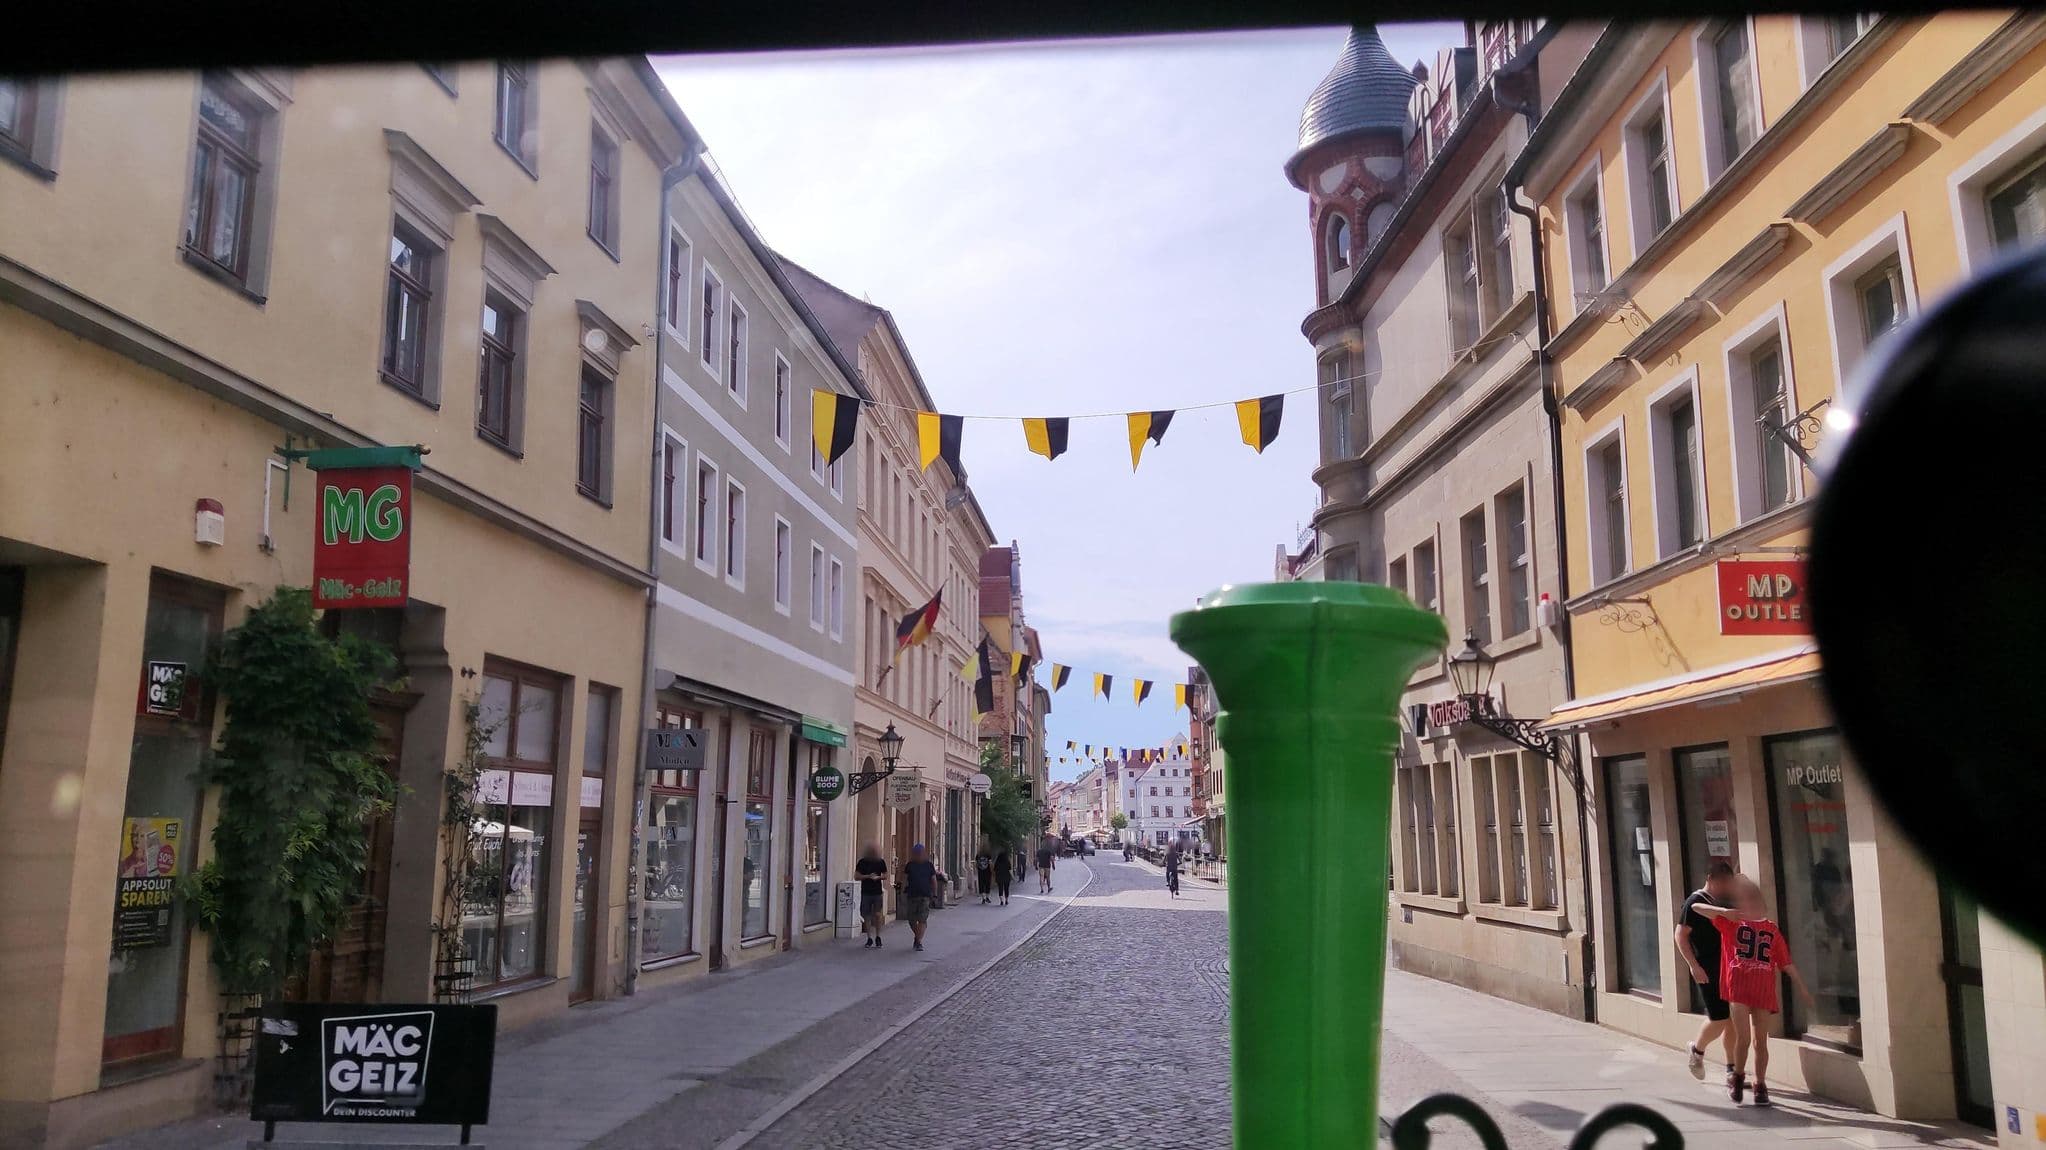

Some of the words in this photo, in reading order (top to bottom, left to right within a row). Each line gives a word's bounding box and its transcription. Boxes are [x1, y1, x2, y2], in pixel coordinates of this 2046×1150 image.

[324, 485, 402, 545] MG
[319, 577, 401, 600] Mäc-Geiz
[1746, 573, 1793, 599] MP
[1726, 604, 1802, 621] OUTLE
[1427, 696, 1488, 728] Volksbak
[1786, 766, 1804, 786] MP
[1806, 764, 1842, 784] Outlet
[122, 879, 172, 892] APPSOLUT
[1735, 925, 1775, 964] 92
[334, 1023, 422, 1057] MÄC
[329, 1060, 418, 1094] GEIZ
[334, 1107, 356, 1116] DEIN
[358, 1108, 416, 1117] DISCOUNTER
